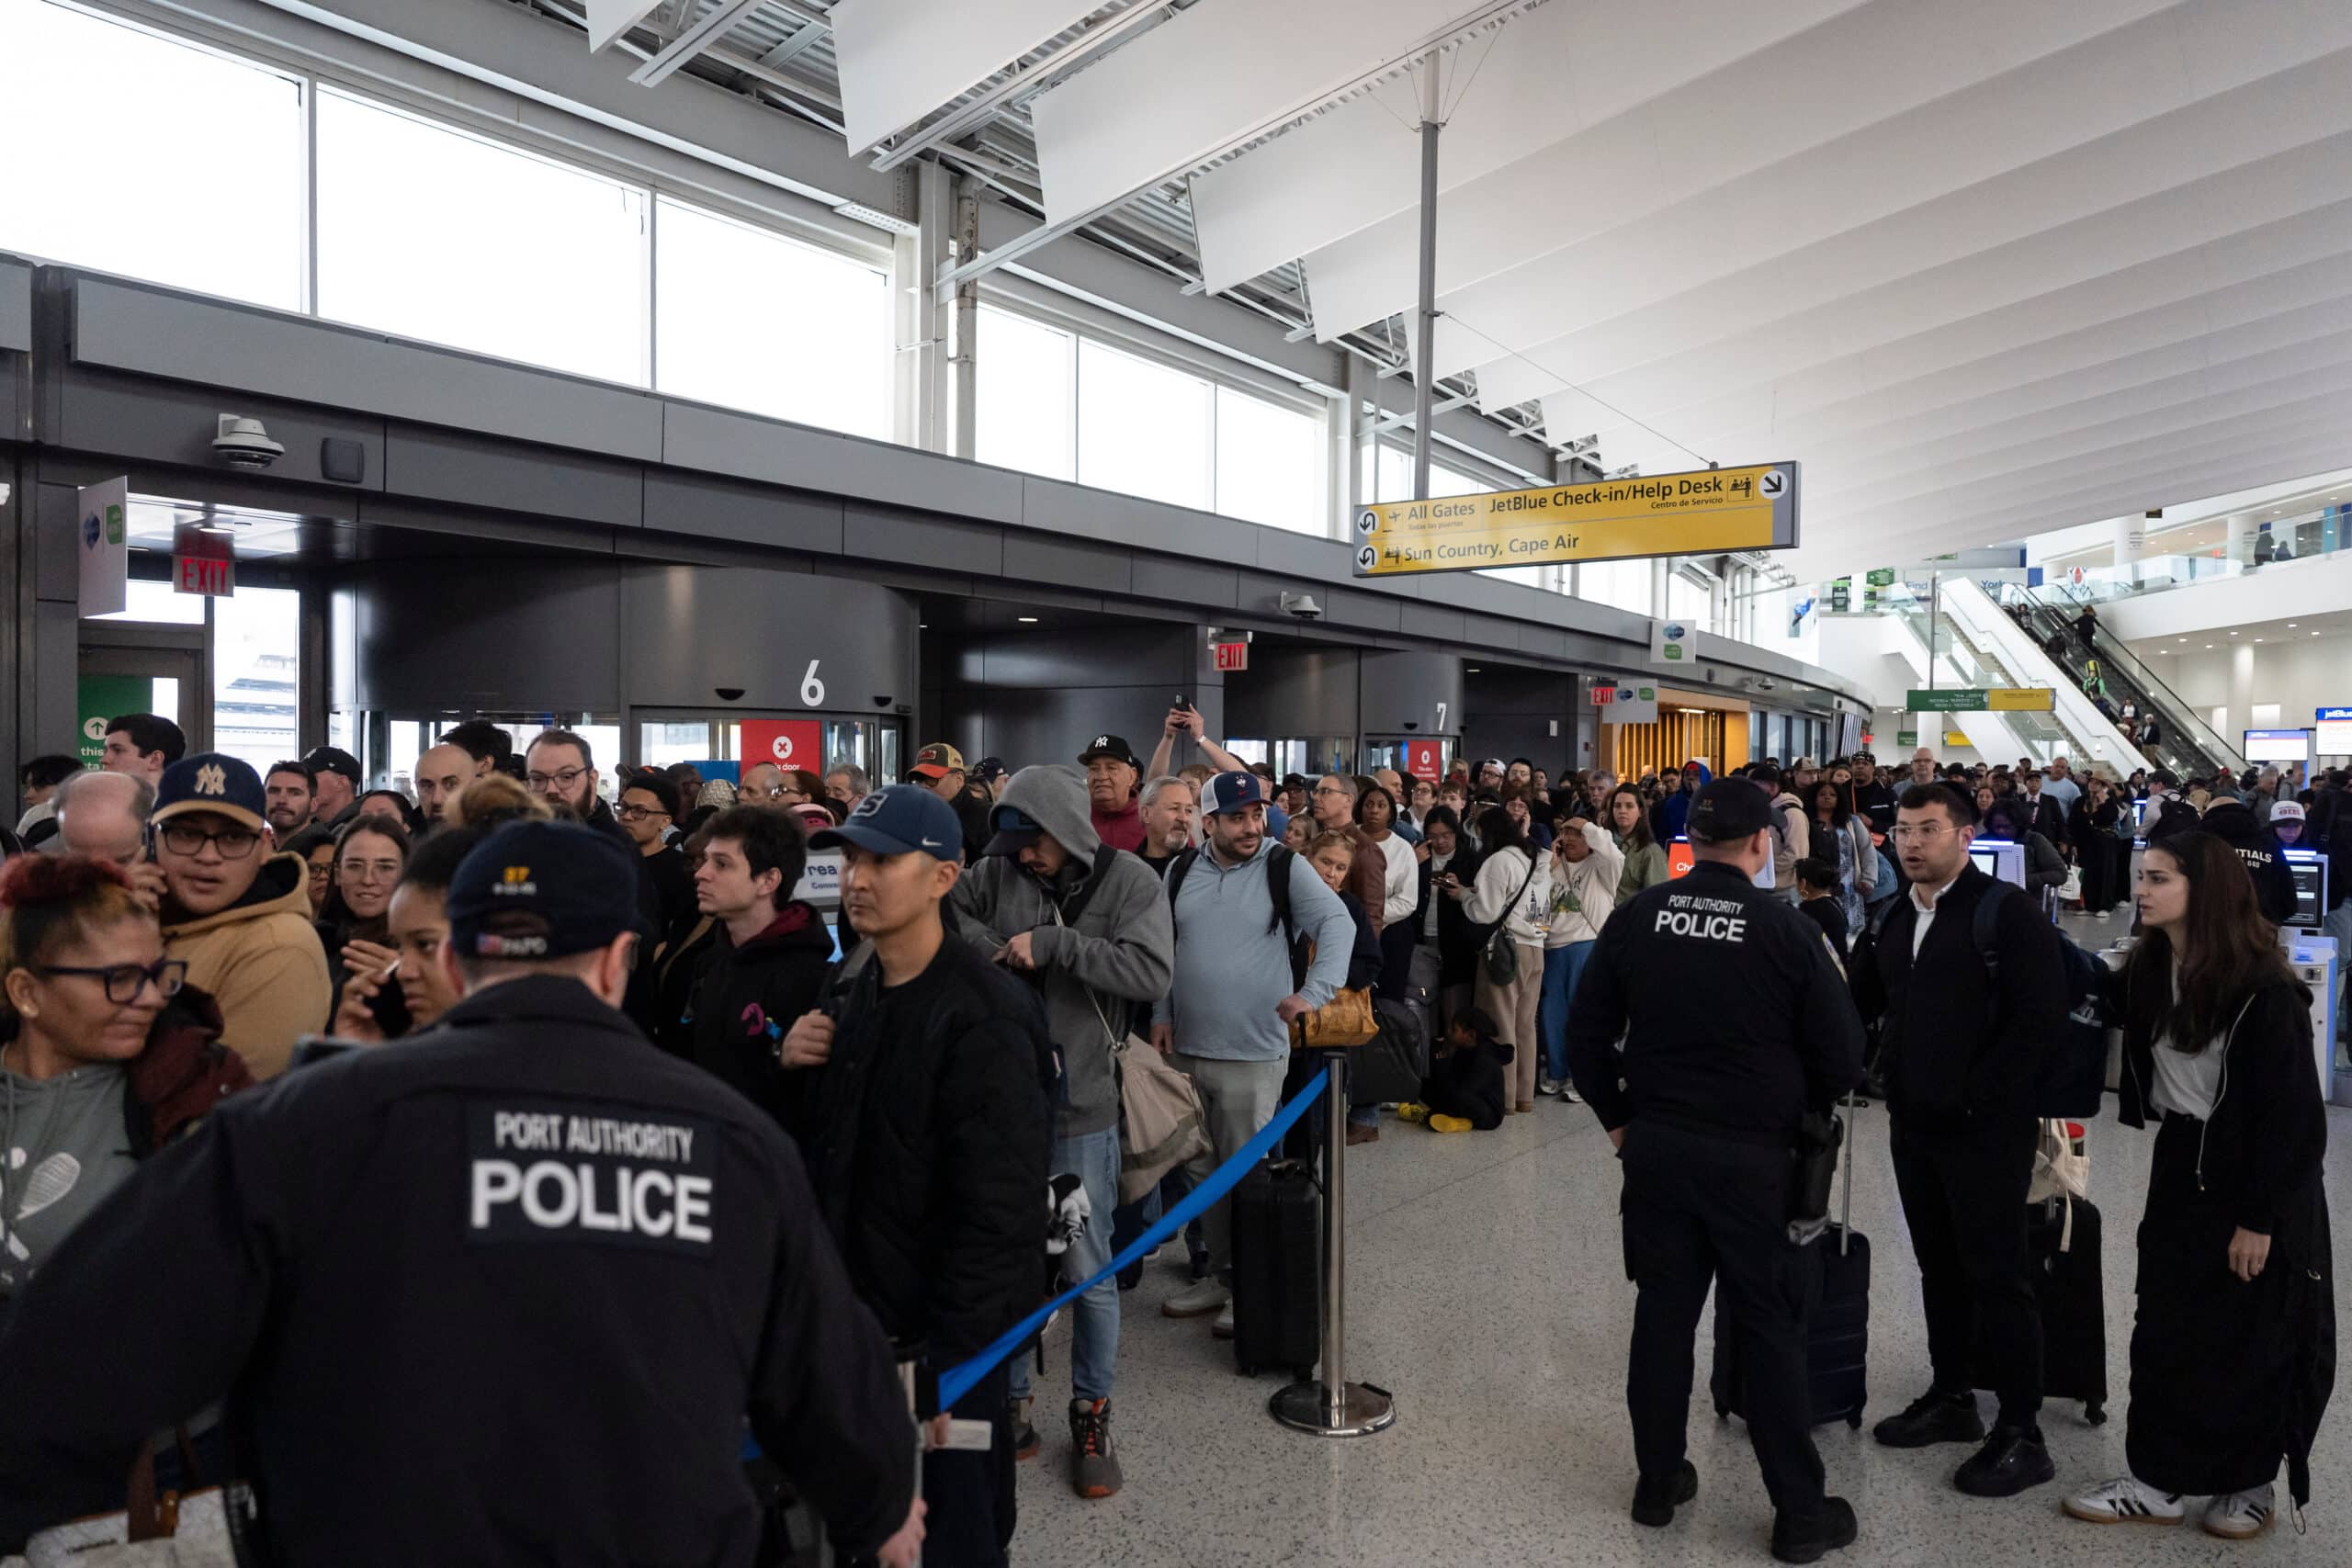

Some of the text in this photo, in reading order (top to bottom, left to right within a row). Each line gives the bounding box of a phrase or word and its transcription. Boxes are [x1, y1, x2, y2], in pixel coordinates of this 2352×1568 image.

[1489, 476, 1723, 513] JetBlue Check-in/Help Desk
[1650, 496, 1724, 510] Centro de Servicio
[1408, 503, 1475, 520] All Gates
[1404, 534, 1579, 561] Sun Country, Cape Air
[182, 558, 229, 594] EXIT
[1217, 643, 1245, 669] EXIT
[800, 660, 825, 707] 6
[1594, 687, 1615, 705] EXIT
[1437, 702, 1447, 731] 7
[783, 762, 800, 771] door
[2235, 848, 2272, 863] TIALS
[1668, 894, 1744, 915] PORT AUTHORITY
[1654, 910, 1747, 942] POLICE
[494, 1111, 694, 1164] PORT AUTHORITY
[470, 1158, 713, 1244] POLICE
